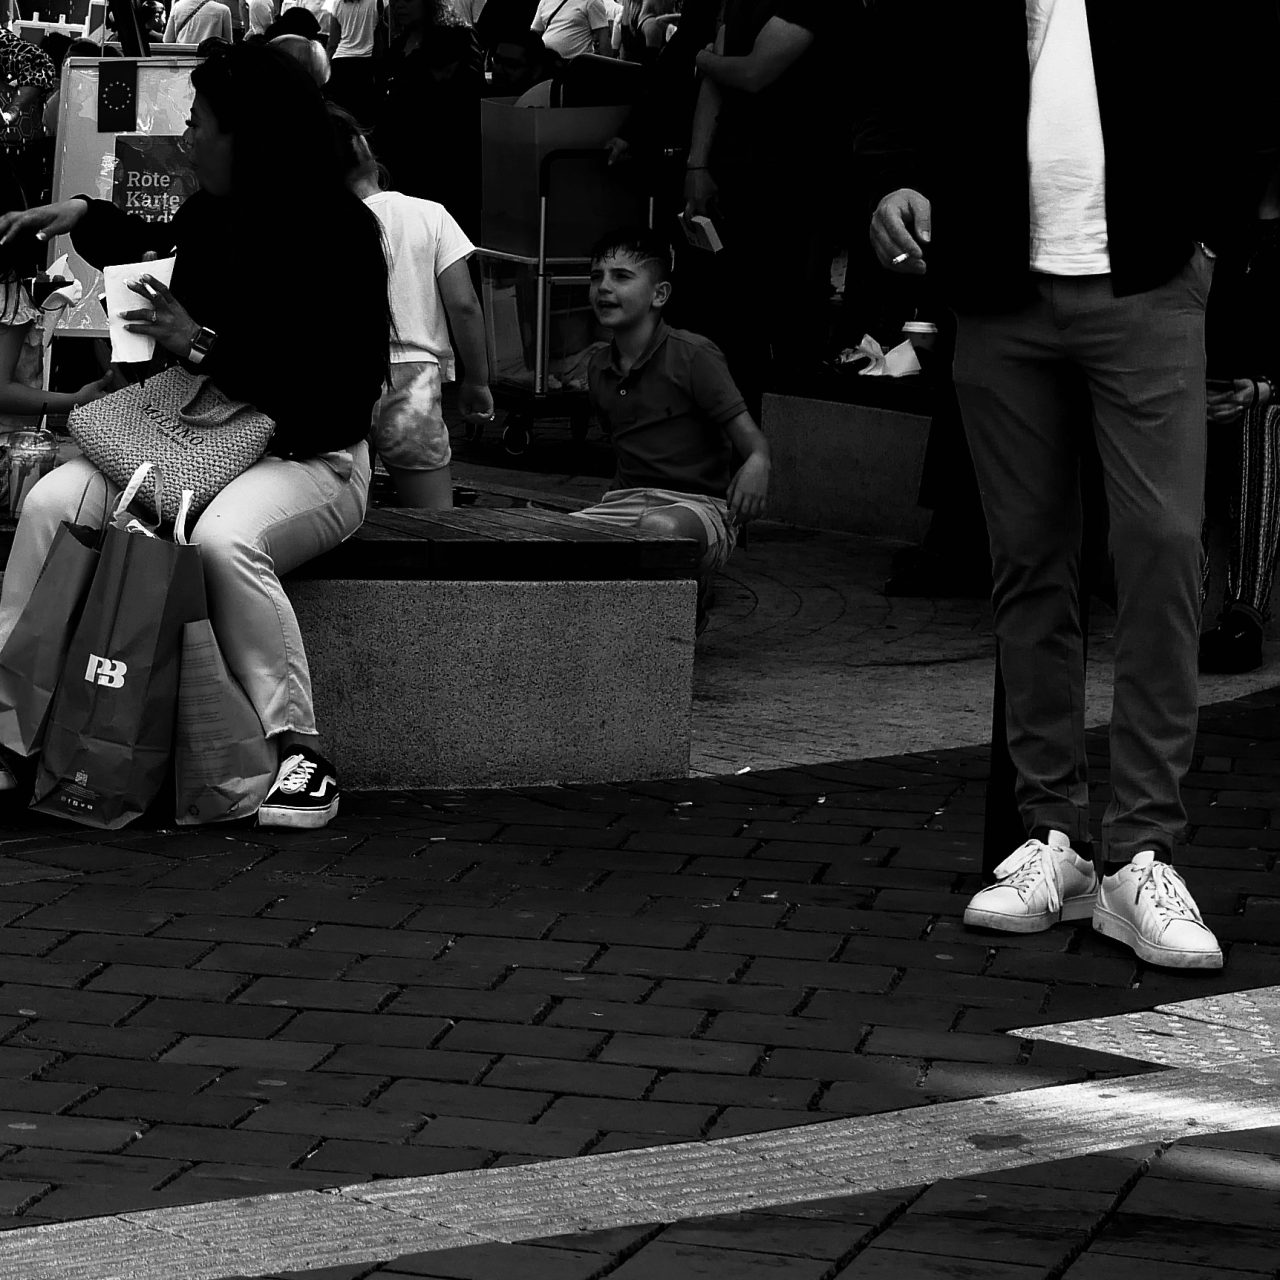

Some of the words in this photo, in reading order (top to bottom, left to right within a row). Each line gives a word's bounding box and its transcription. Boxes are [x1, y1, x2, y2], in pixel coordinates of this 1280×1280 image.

[127, 171, 171, 187] Rote
[125, 191, 180, 208] Karte
[143, 404, 204, 445] MILANO
